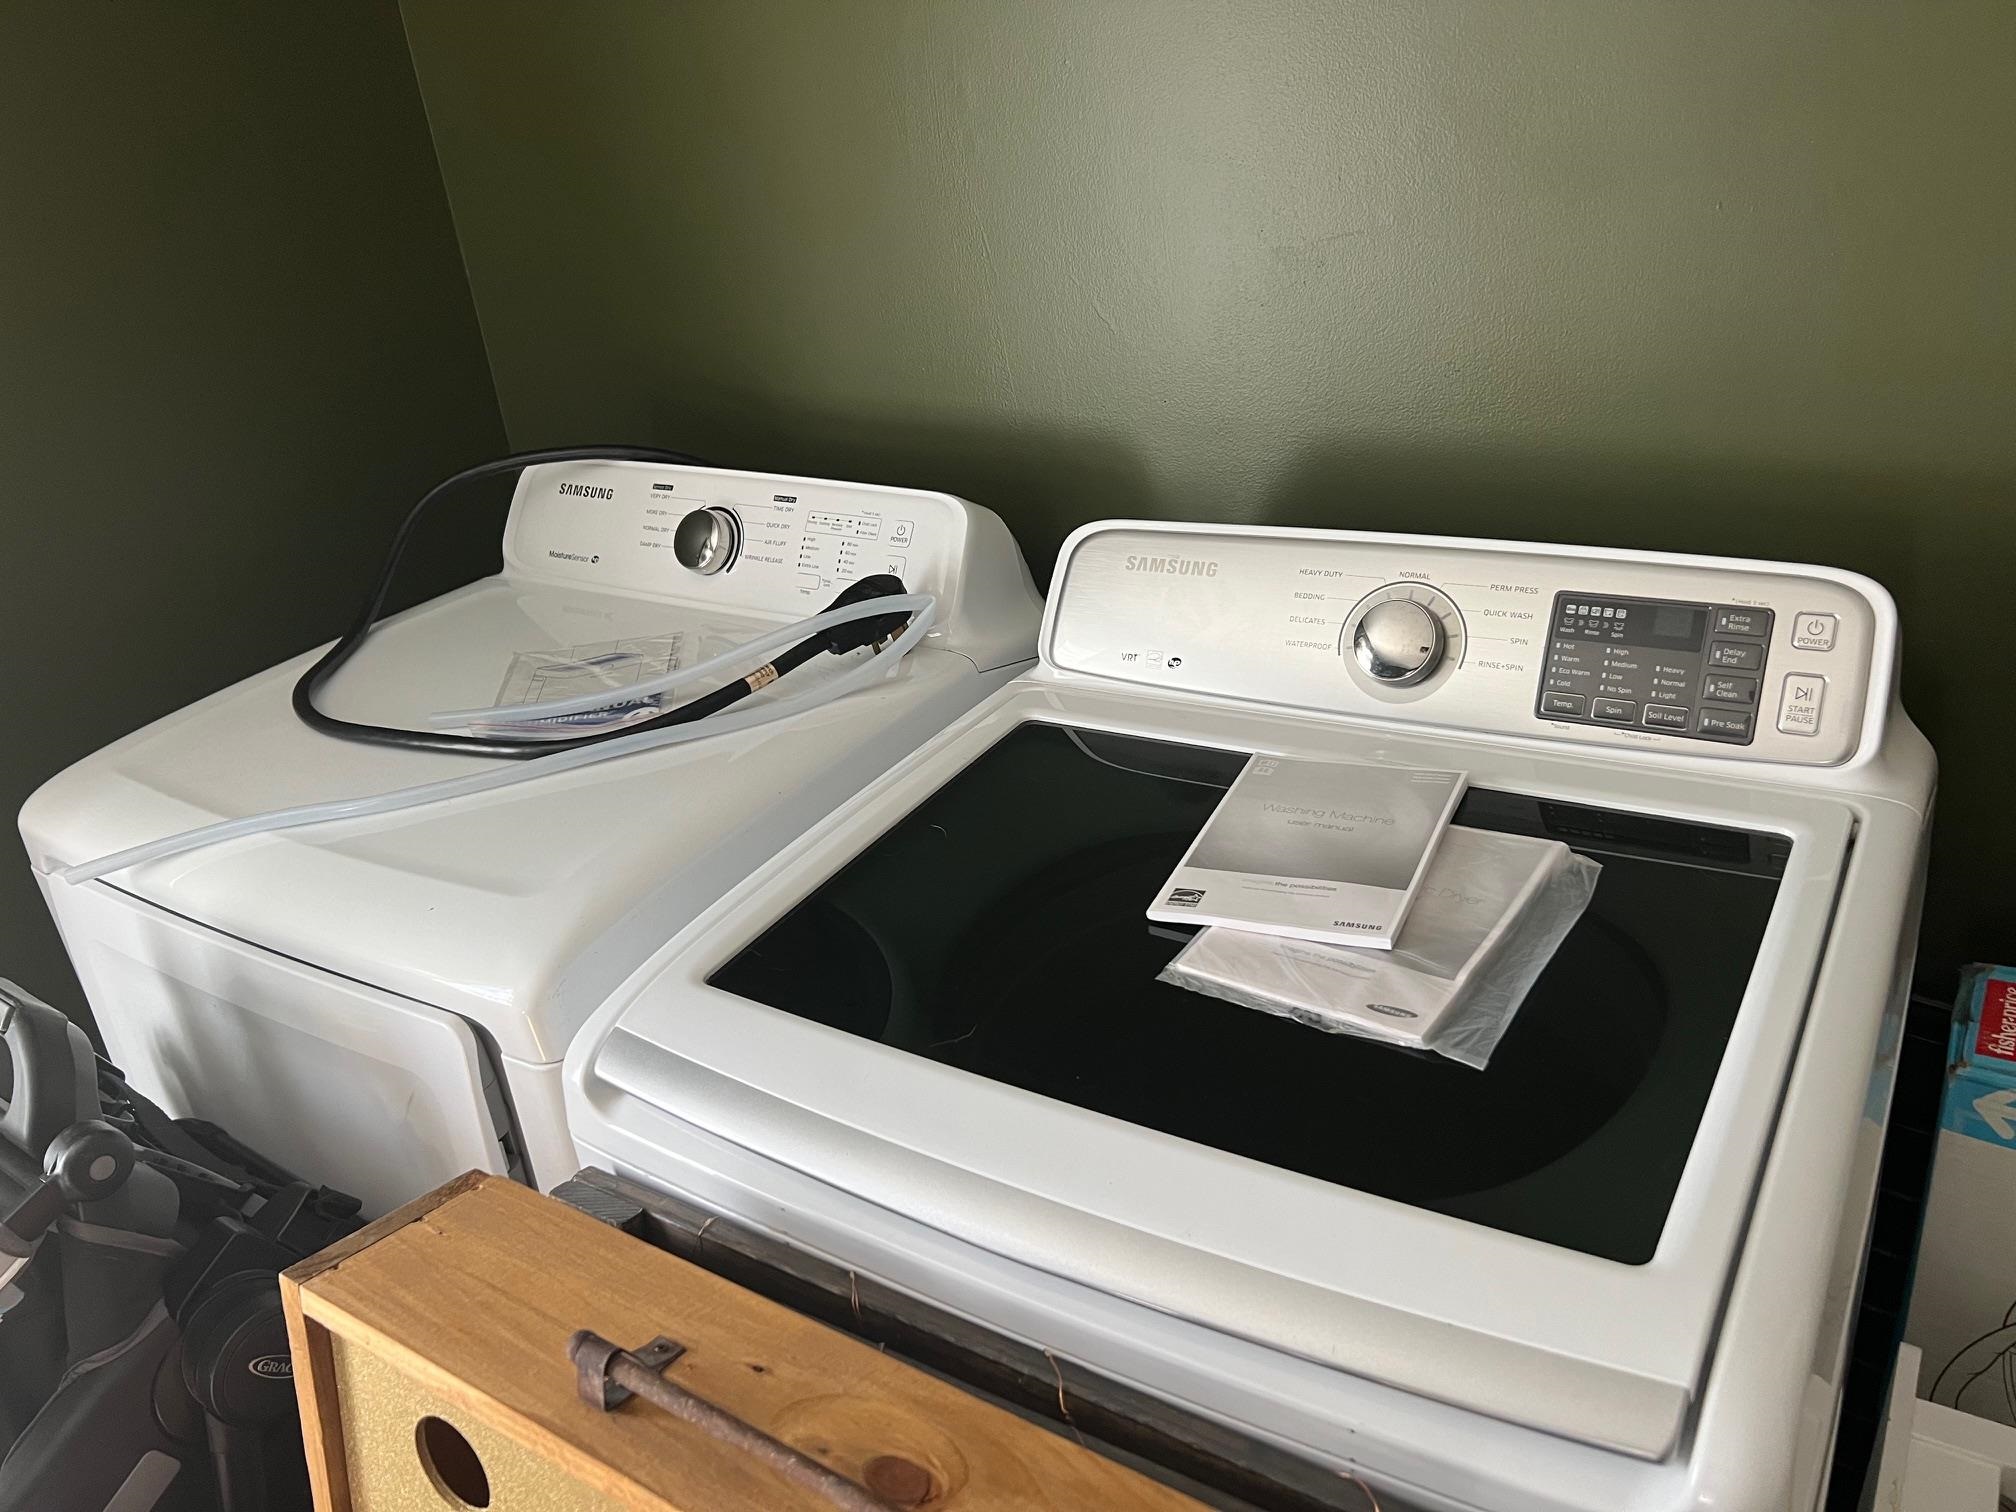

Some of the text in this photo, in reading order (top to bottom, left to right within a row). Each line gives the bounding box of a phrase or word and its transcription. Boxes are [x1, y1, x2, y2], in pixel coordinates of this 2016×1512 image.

[559, 483, 614, 500] SAMSUNG
[891, 536, 908, 544] POWER
[744, 554, 764, 562] WRINKLE
[1125, 555, 1218, 577] SAMSUNG
[1299, 568, 1322, 577] HEAVY
[1399, 571, 1431, 580] NORMAL
[1490, 584, 1539, 595] PERM PRESS
[1294, 592, 1326, 601] BEDDING
[1483, 609, 1533, 620] QUICK WASH
[1729, 615, 1751, 623] Extra
[1289, 616, 1326, 625] DELICATES
[1728, 622, 1750, 632] Rinse
[1285, 639, 1332, 650] WATERPROOF
[1510, 637, 1529, 646] SPIN
[1562, 642, 1576, 650] Hot
[1797, 637, 1829, 646] POWER
[1613, 648, 1629, 656] High
[1723, 648, 1746, 658] Delay
[1722, 656, 1738, 664] End
[1478, 660, 1524, 672] RINSE+SPIN
[1611, 661, 1638, 669] Medium
[1571, 669, 1591, 677] Warm
[1662, 666, 1685, 675] Heavy
[1556, 679, 1571, 687] Cold
[1661, 679, 1686, 687] Normal
[1717, 681, 1733, 690] Self
[1617, 686, 1632, 694] Spin
[1716, 690, 1738, 698] Clean
[1553, 700, 1574, 708] Temp.
[1606, 706, 1622, 714] Spin
[1788, 705, 1815, 714] START
[1648, 711, 1685, 722] Soil Level
[1785, 715, 1814, 724] PAUSE
[1711, 719, 1745, 730] Pre Soak
[1263, 803, 1395, 826] Washing Machine
[1287, 819, 1354, 832] user manual
[1439, 888, 1487, 905] Dryer
[1332, 920, 1383, 931] SAMSUNG
[257, 1360, 293, 1373] GRAC
